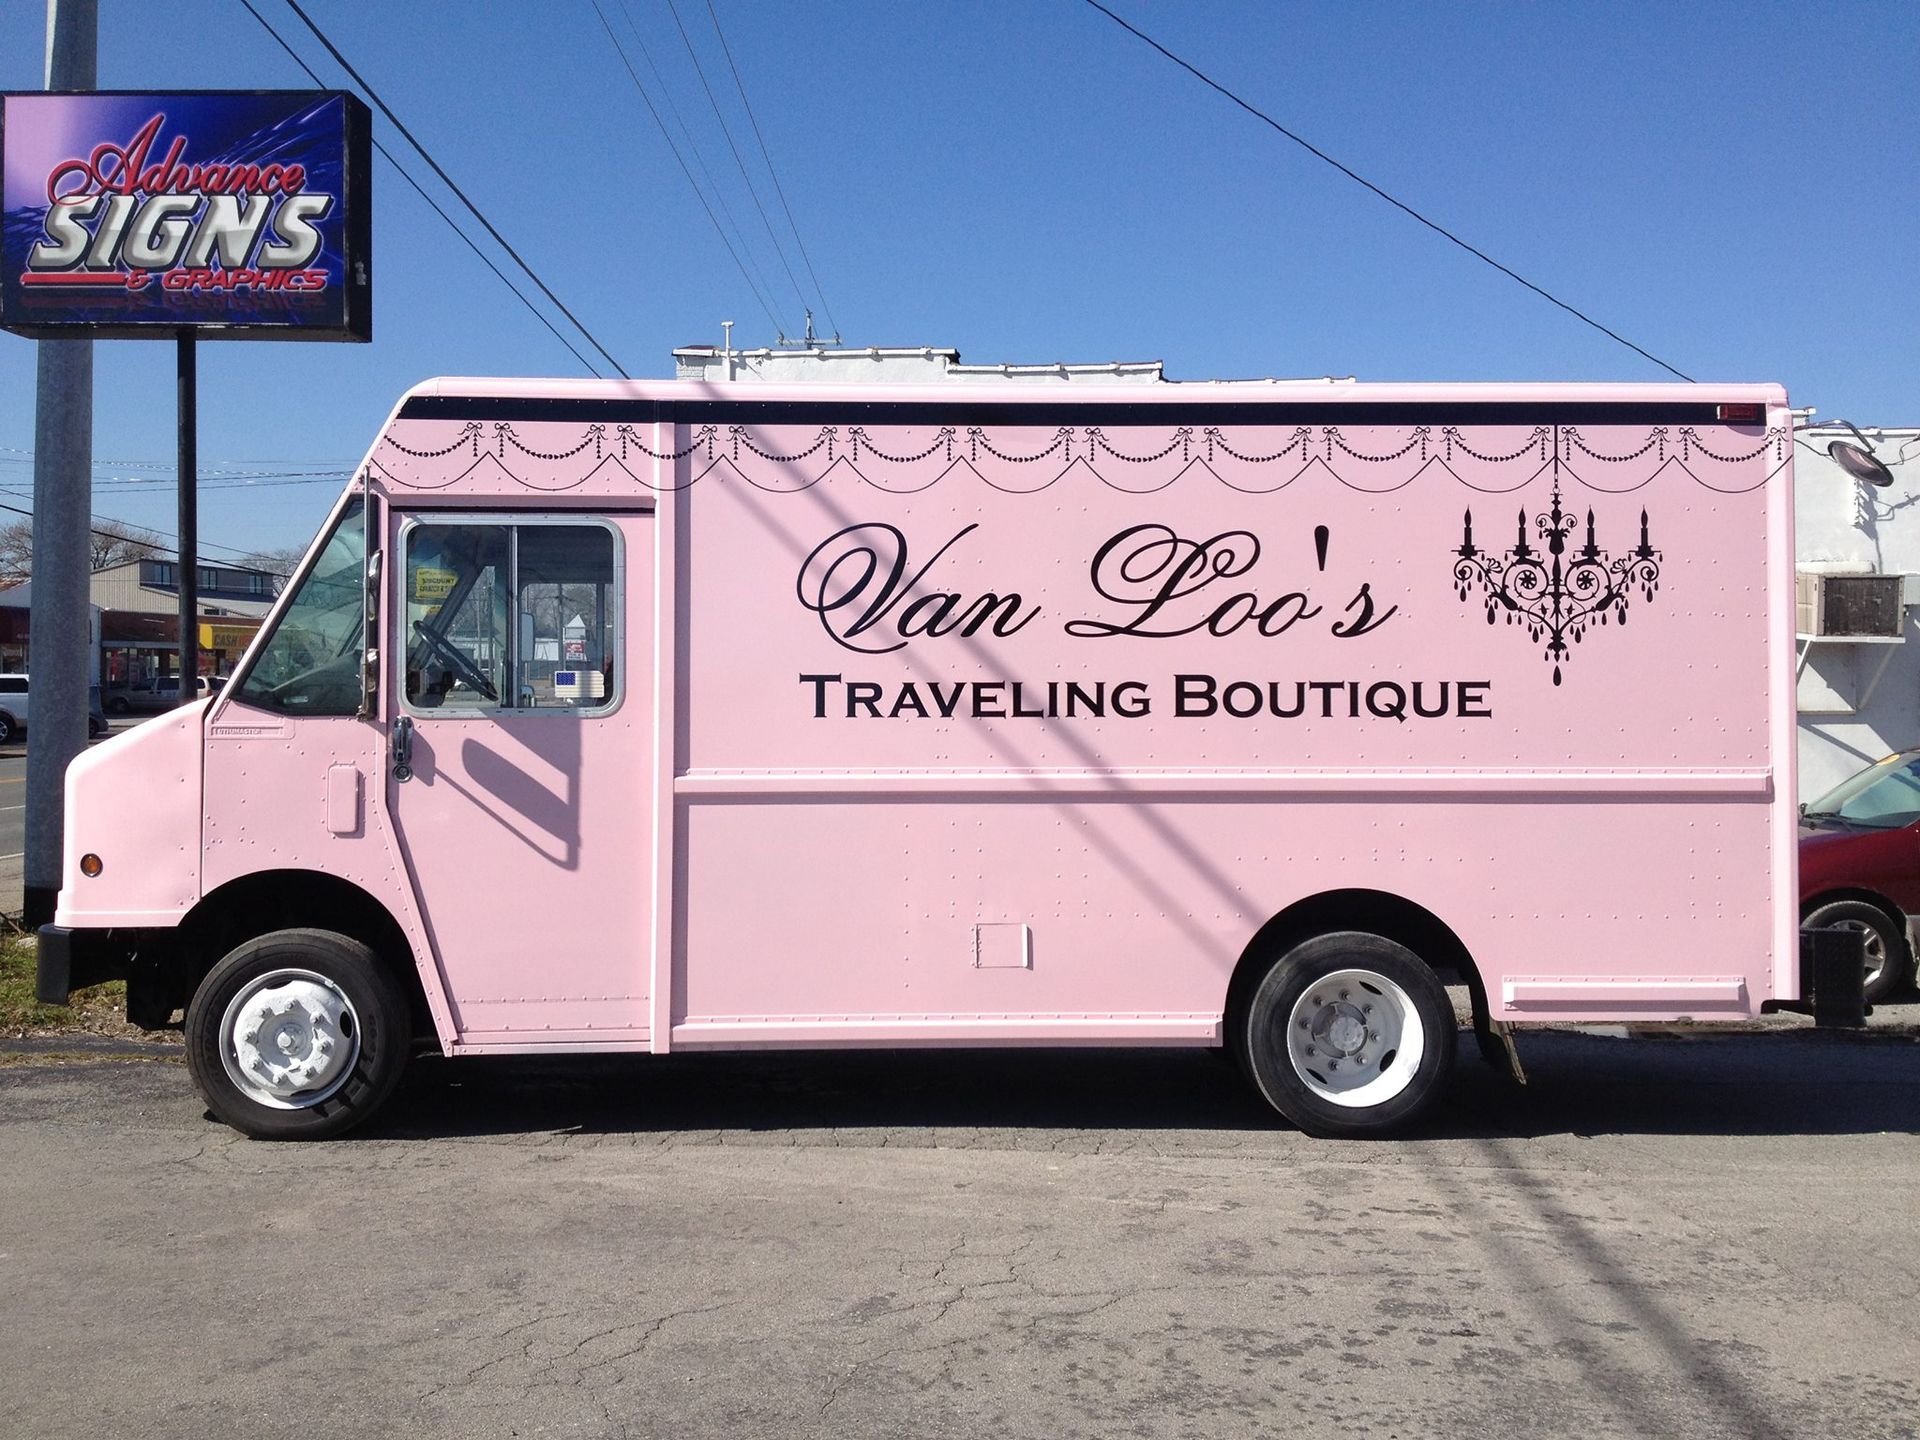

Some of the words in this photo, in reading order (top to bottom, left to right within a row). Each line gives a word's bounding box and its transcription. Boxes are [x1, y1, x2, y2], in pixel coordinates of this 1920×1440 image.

[48, 112, 306, 206] Advance
[28, 194, 334, 271] SIGNS
[127, 268, 151, 289] &
[163, 269, 329, 290] GRAPHICS
[796, 523, 1041, 655] Van
[1064, 523, 1398, 638] Loo's
[800, 673, 1151, 719] TRAVELING
[1173, 673, 1492, 723] BOUTIQUE
